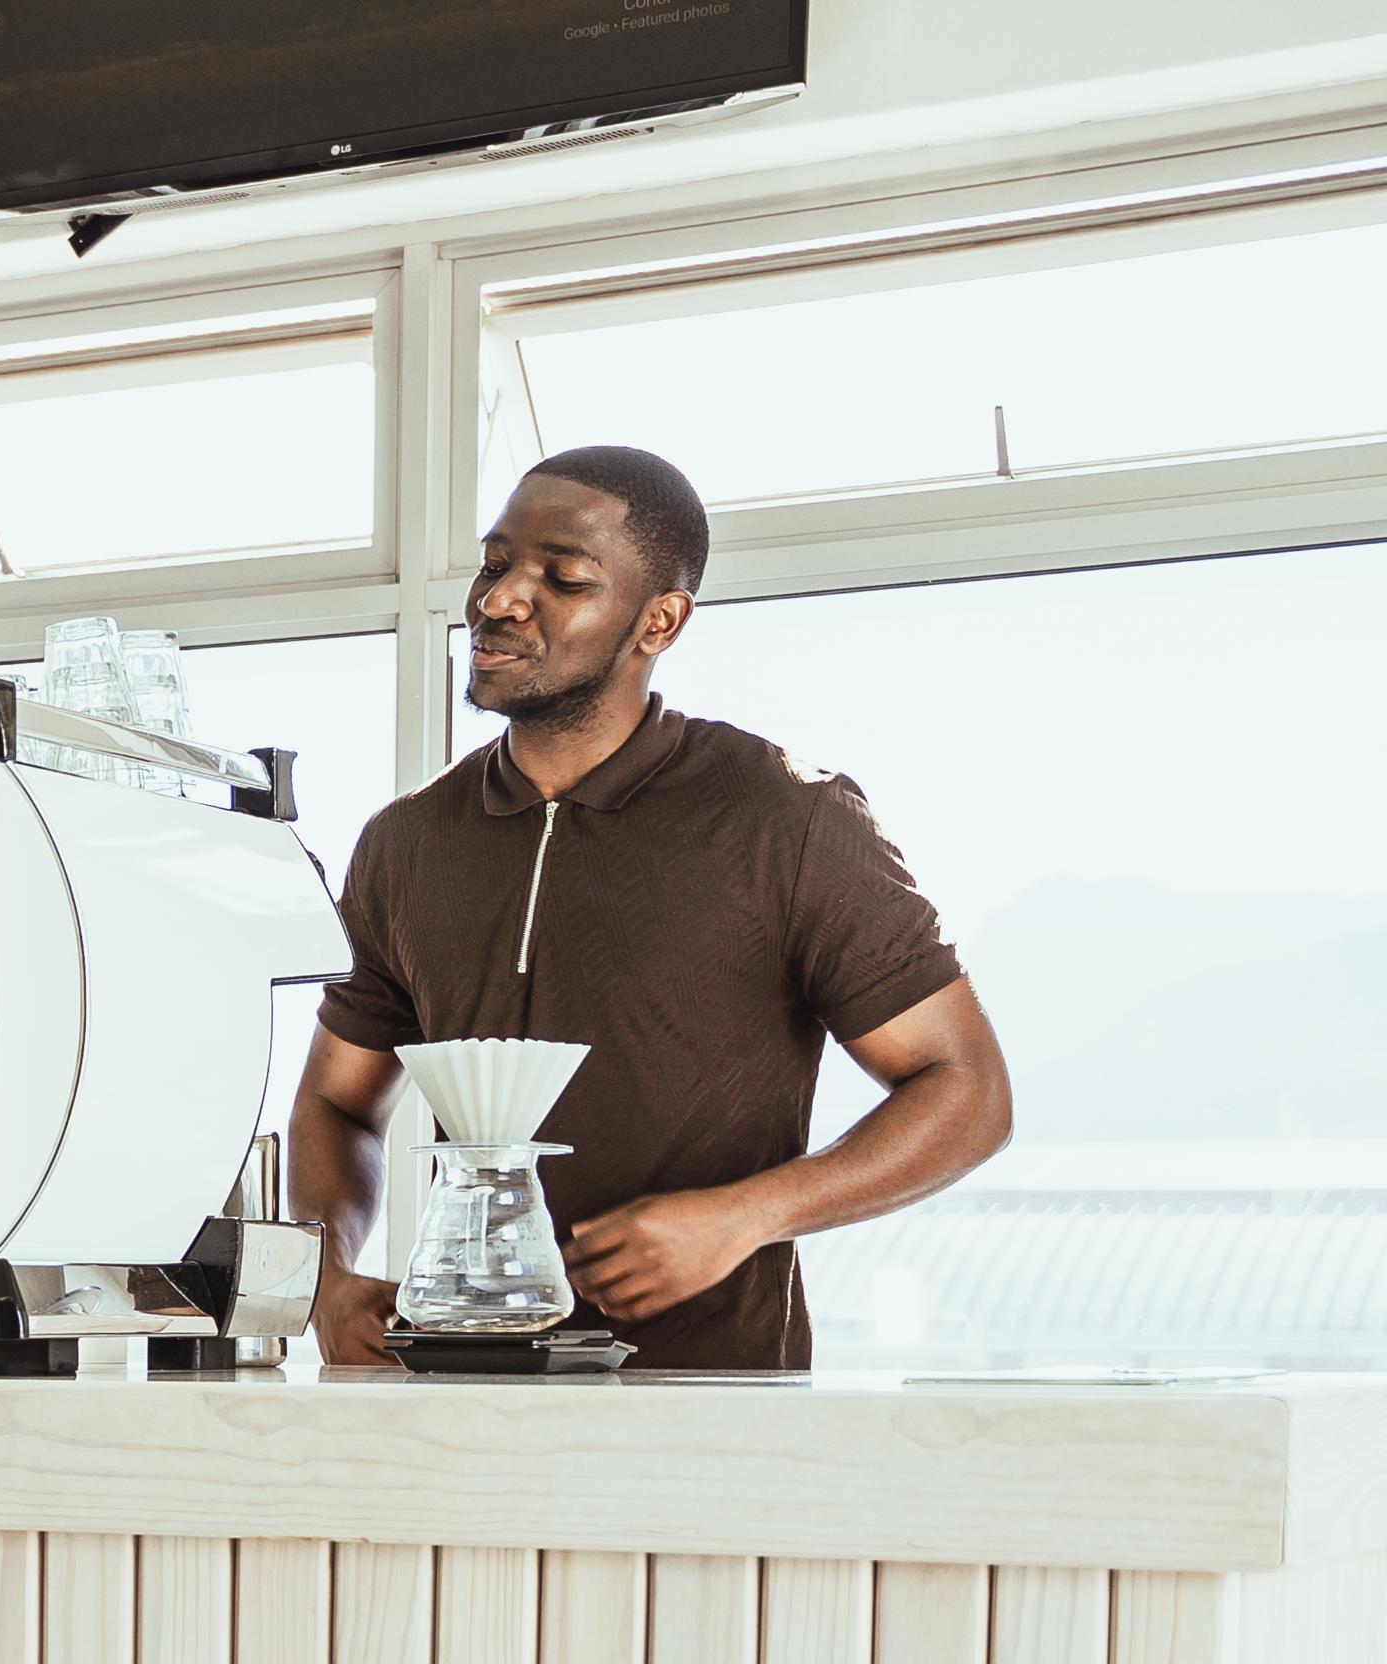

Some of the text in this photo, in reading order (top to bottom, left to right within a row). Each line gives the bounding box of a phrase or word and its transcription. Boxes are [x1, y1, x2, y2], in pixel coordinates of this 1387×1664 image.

[563, 2, 730, 40] Google Featured photos
